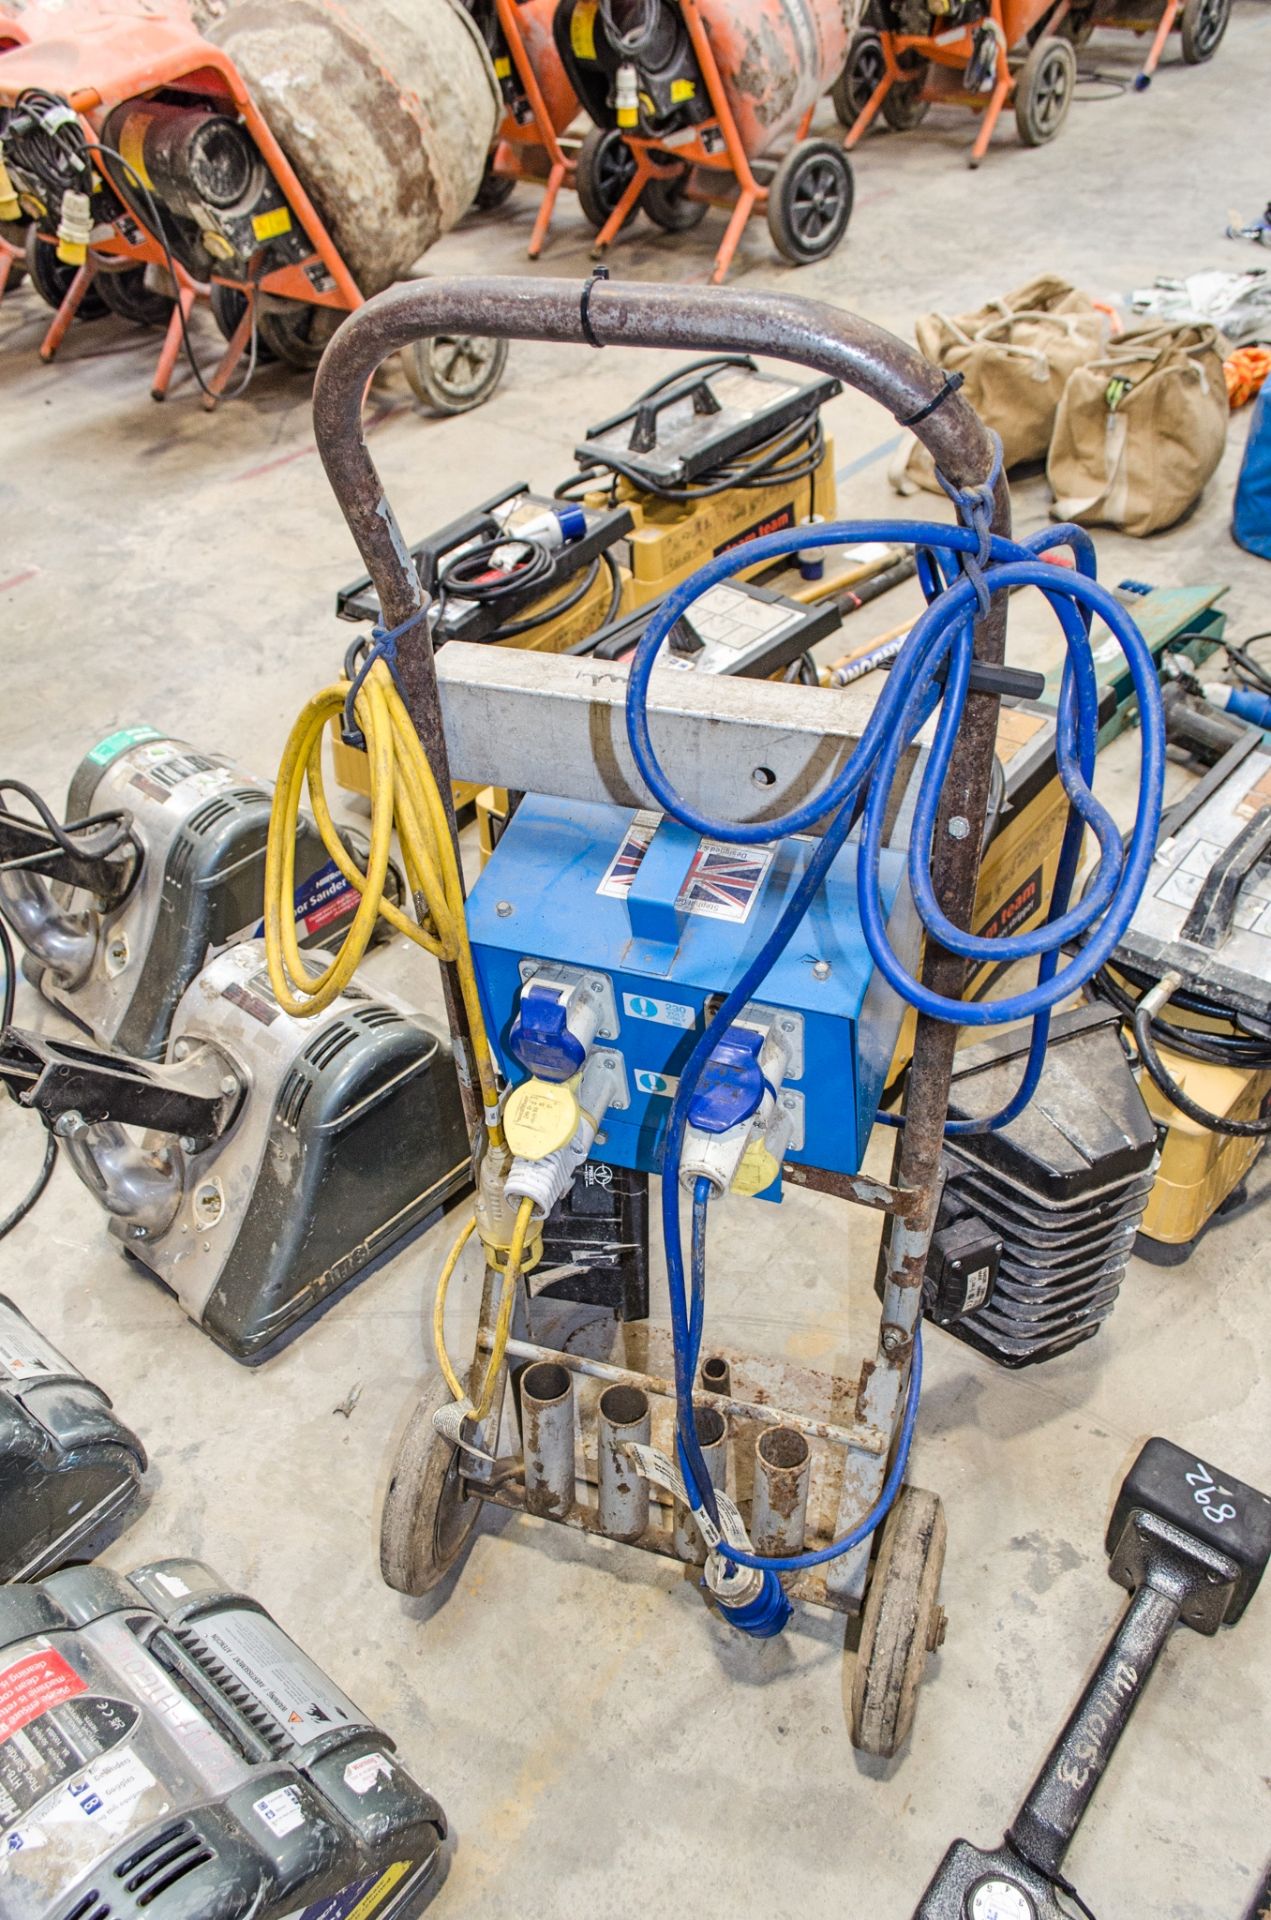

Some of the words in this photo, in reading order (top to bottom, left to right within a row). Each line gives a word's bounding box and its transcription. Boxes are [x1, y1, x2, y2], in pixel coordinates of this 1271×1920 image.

[709, 846, 748, 859] Designed
[309, 878, 347, 906] Sander
[7, 1655, 48, 1685] cleaning
[27, 1671, 65, 1699] machine
[0, 1743, 28, 1772] Sander
[20, 1768, 43, 1792] Floor
